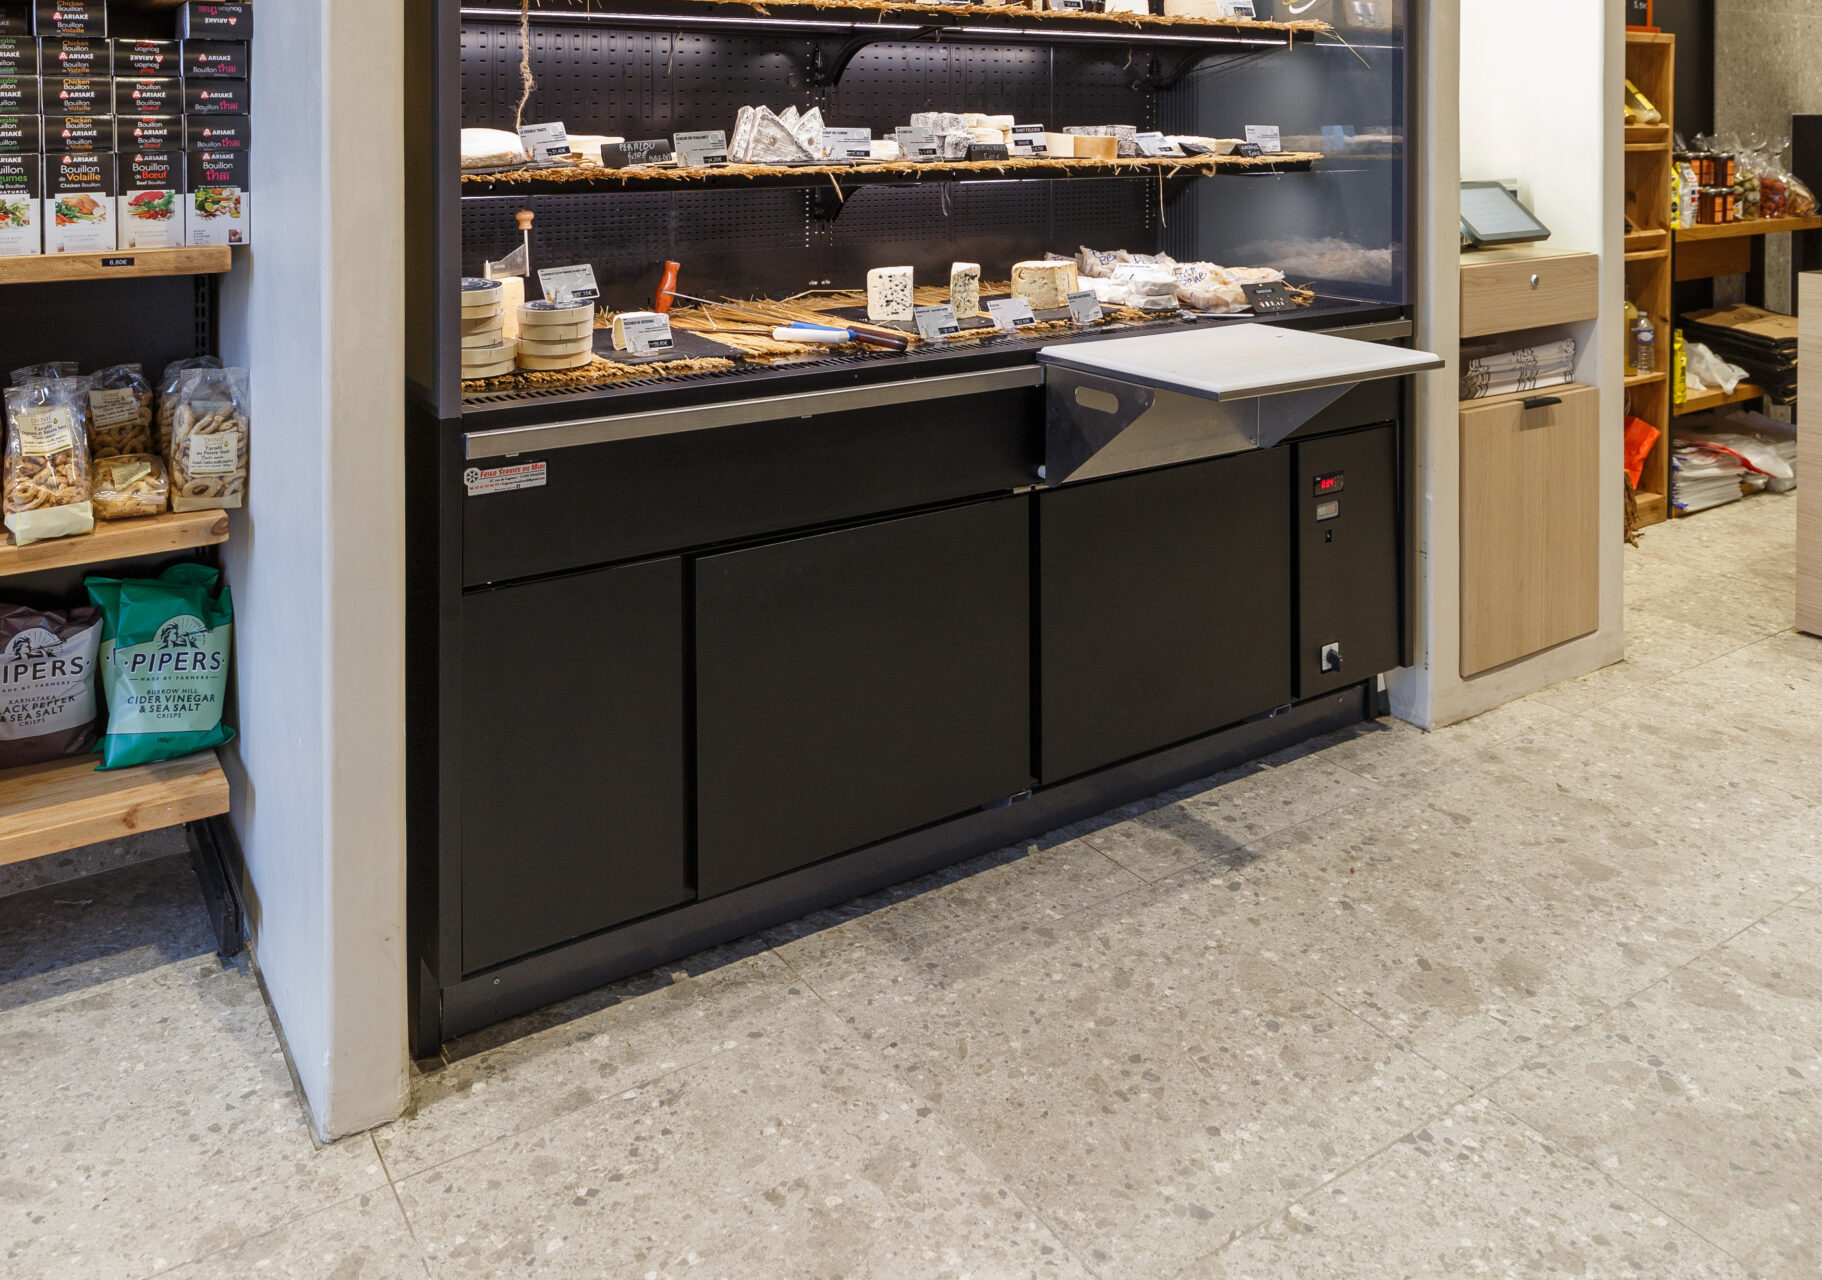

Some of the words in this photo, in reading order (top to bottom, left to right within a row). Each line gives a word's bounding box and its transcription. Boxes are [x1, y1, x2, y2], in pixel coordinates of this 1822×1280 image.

[60, 164, 100, 174] Bouillon
[132, 163, 169, 172] Bouillon
[203, 161, 234, 169] Bouillon
[66, 172, 101, 182] Volaille
[206, 169, 230, 181] thaï
[130, 650, 221, 673] PIPERS
[35, 680, 70, 688] FARMERS
[146, 688, 178, 696] BURROW
[9, 694, 57, 705] KARNATAKA
[32, 694, 76, 711] PEPPER
[127, 695, 162, 705] CIDER
[164, 694, 216, 704] VINEGAR
[139, 705, 147, 713] &
[149, 704, 171, 713] SEA
[173, 703, 201, 712] SALT
[10, 712, 33, 722] SEA
[35, 705, 65, 719] SALT
[19, 718, 46, 727] CRISPS
